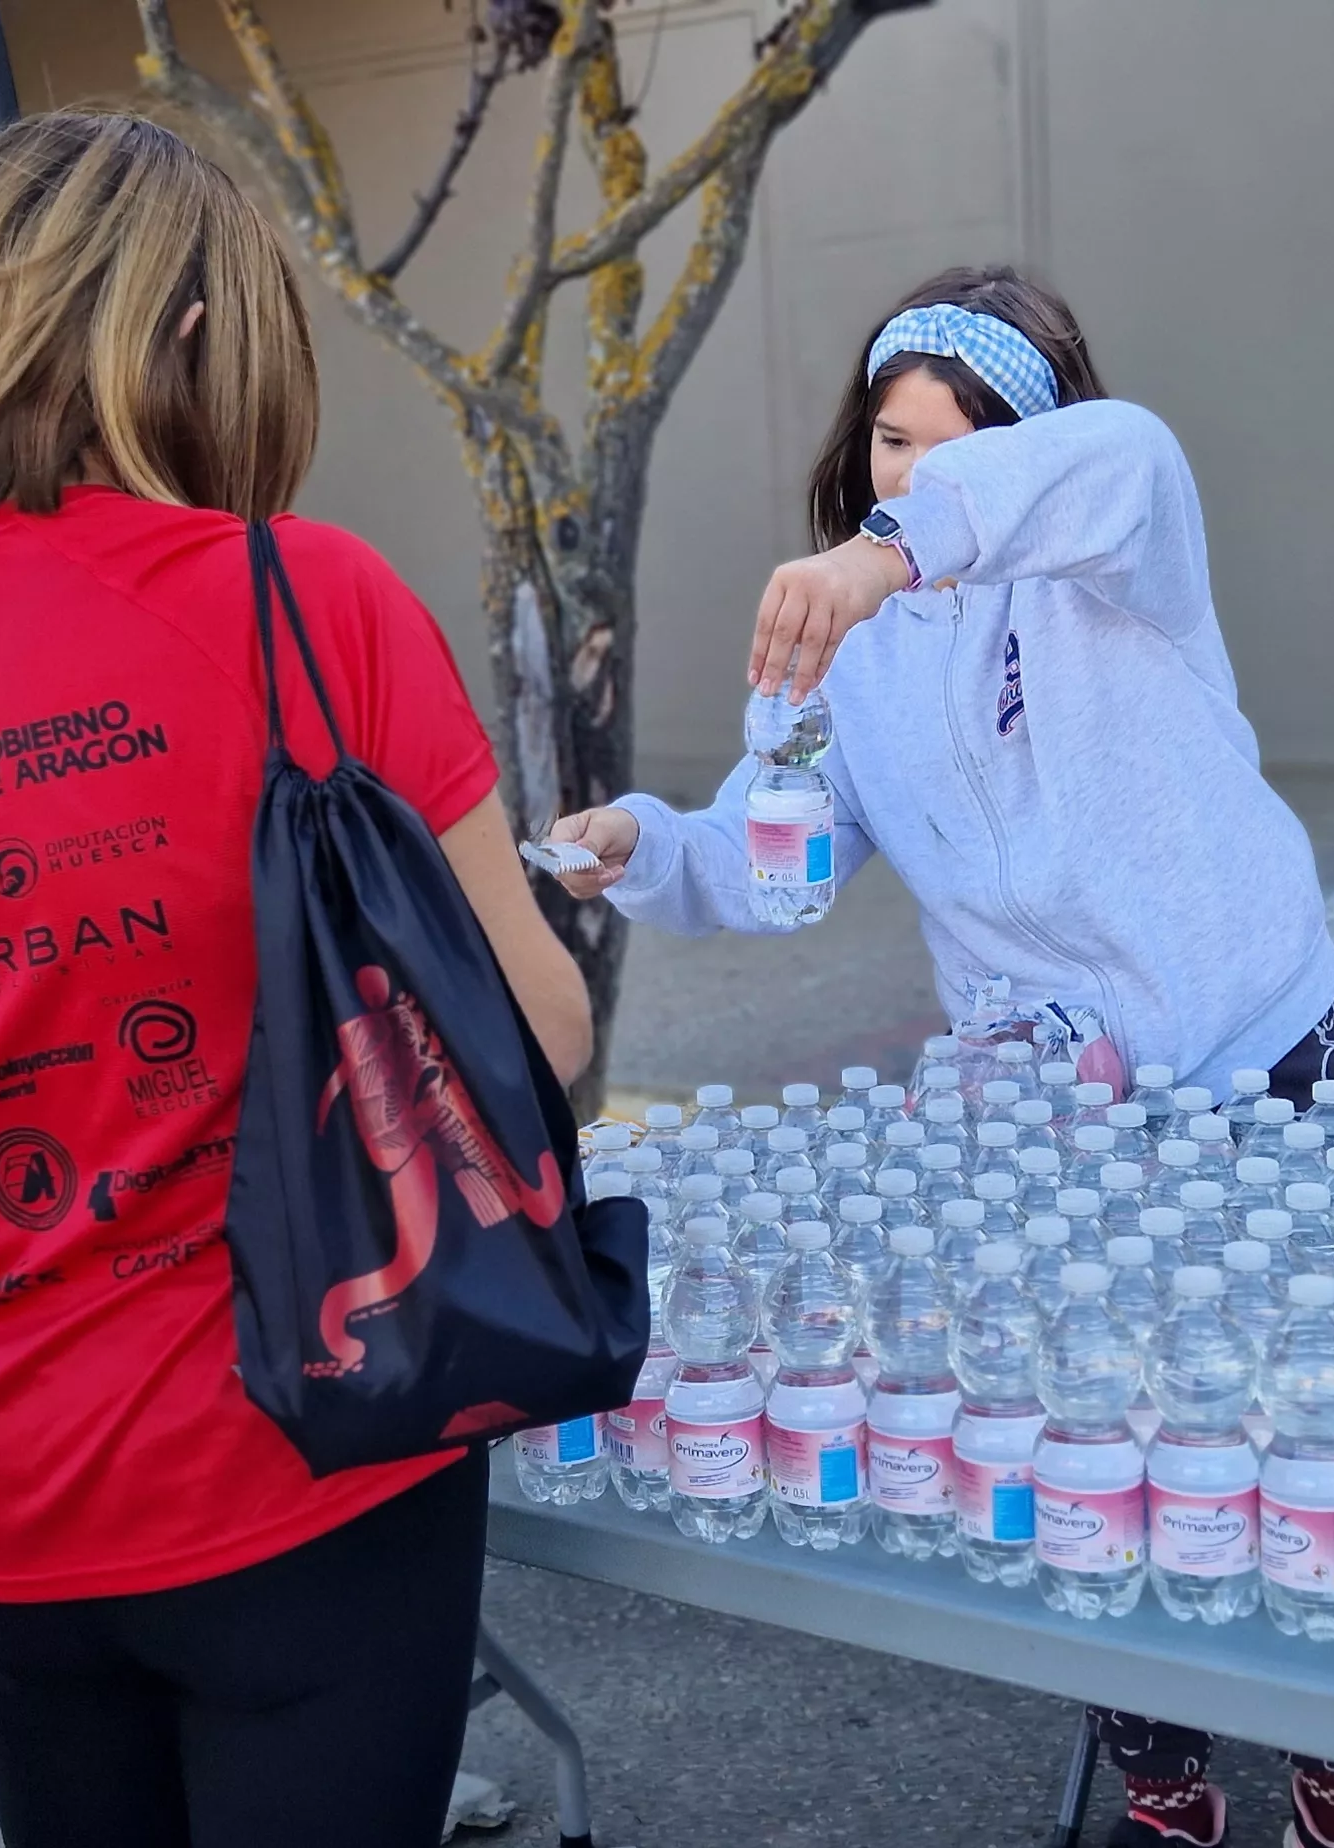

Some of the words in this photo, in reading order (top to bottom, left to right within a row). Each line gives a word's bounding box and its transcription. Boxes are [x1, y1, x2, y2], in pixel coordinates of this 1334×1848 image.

[15, 724, 169, 790] ARAGON
[45, 815, 167, 858] DIPUTACIÓN
[49, 833, 170, 874] HUESCA
[126, 1057, 217, 1104] MIGUEL
[134, 1085, 225, 1120] ESCUER
[675, 1442, 744, 1458] Primavera
[1162, 1514, 1241, 1533] Primavera
